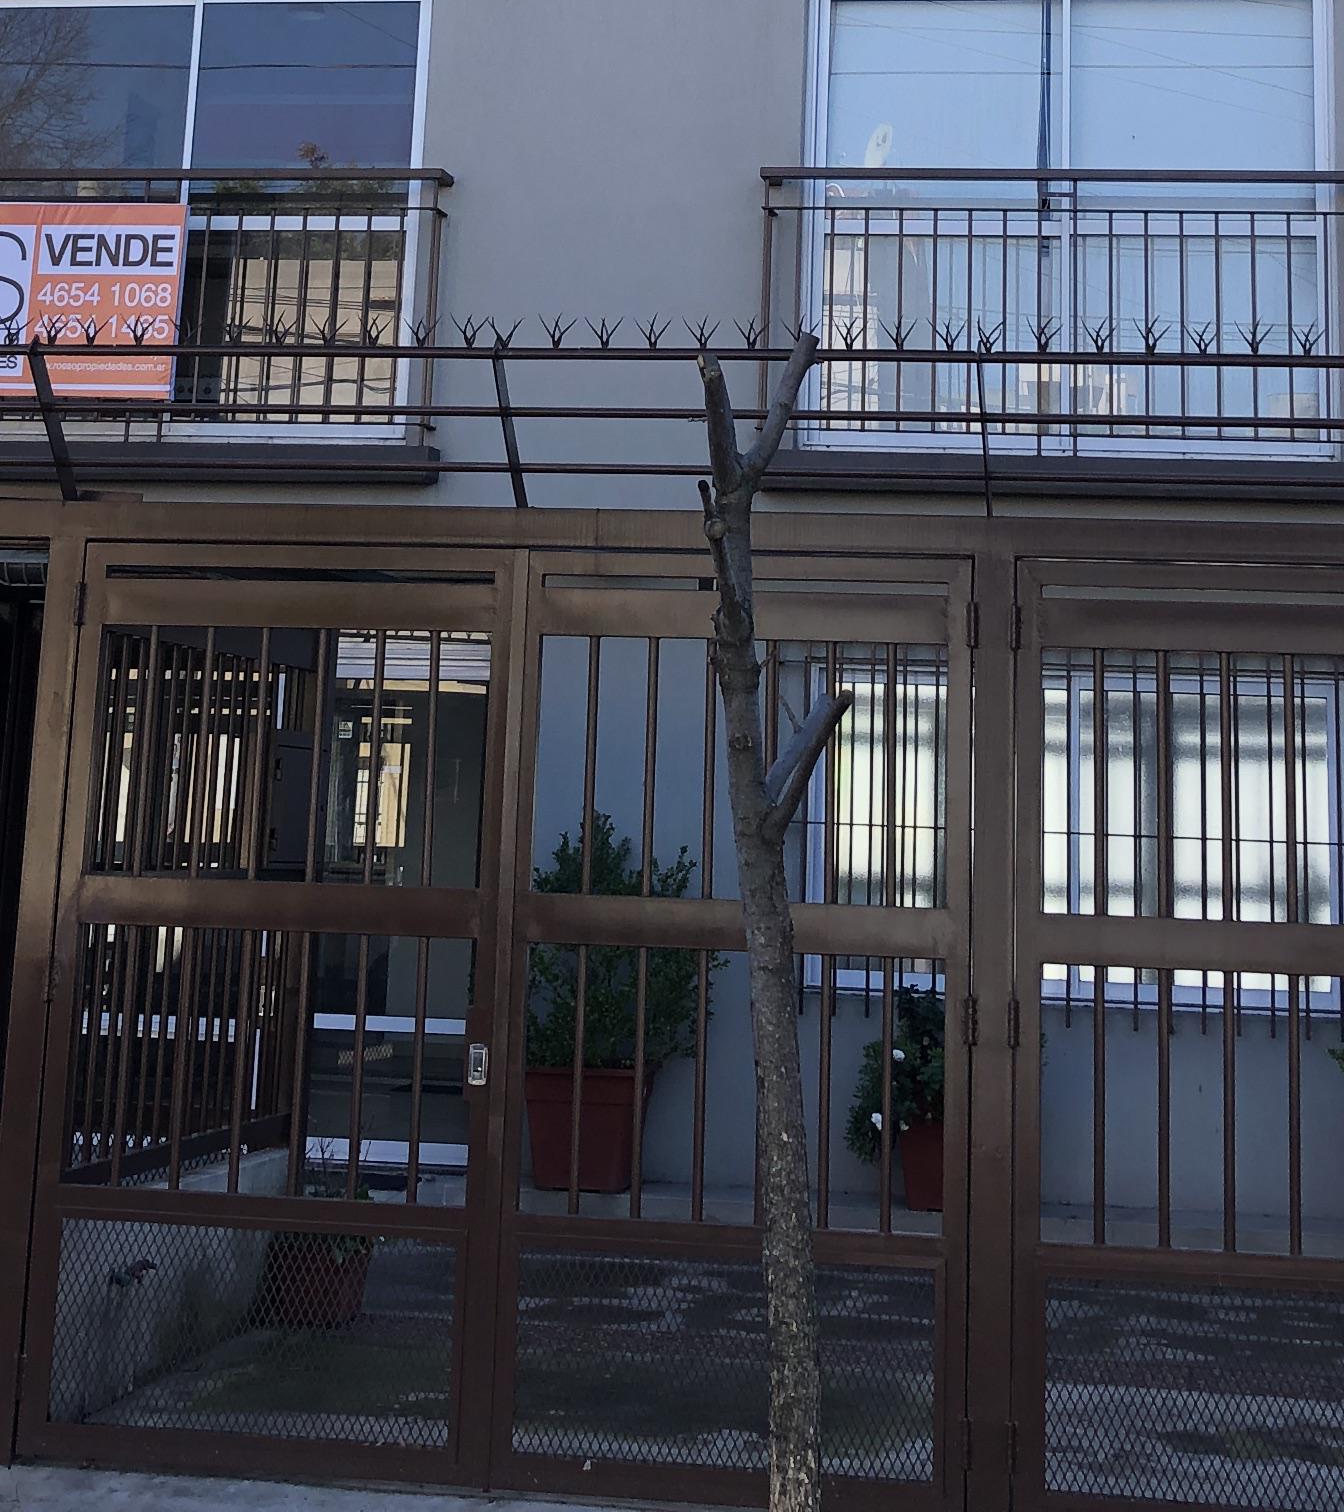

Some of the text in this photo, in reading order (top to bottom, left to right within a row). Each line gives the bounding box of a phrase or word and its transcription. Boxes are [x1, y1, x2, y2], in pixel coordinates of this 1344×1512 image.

[44, 233, 176, 267] VENDE
[37, 281, 172, 307] 4654 1068
[34, 314, 96, 338] 4654
